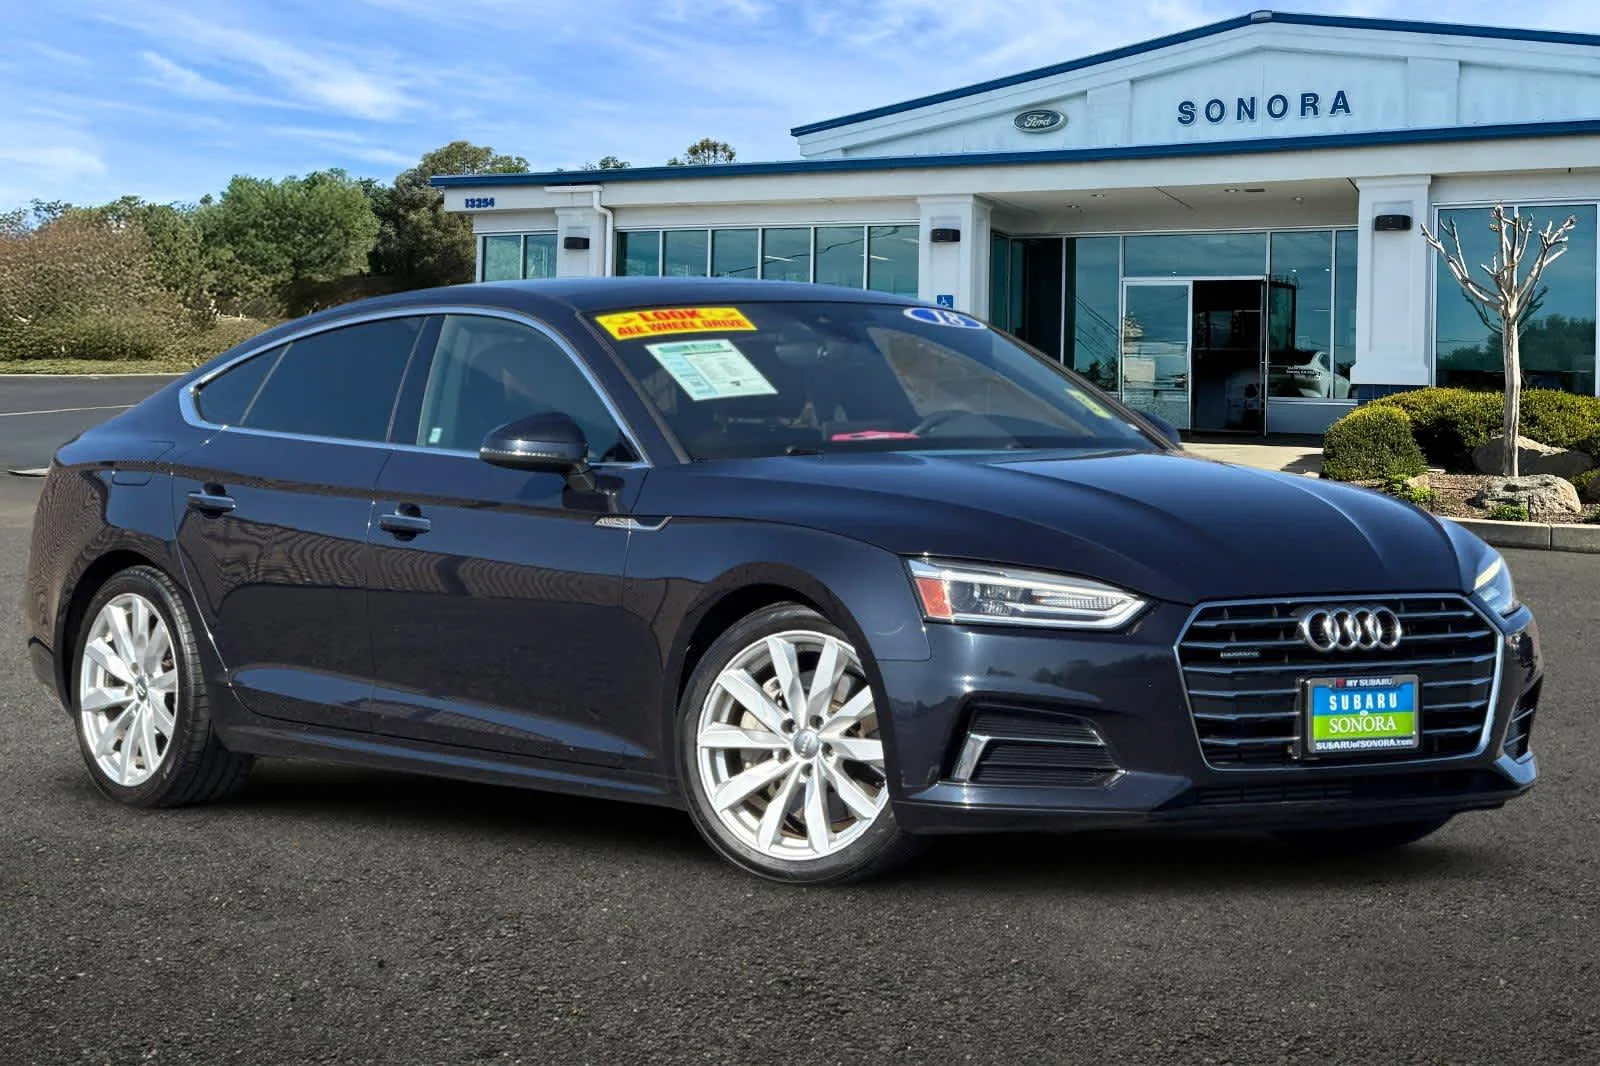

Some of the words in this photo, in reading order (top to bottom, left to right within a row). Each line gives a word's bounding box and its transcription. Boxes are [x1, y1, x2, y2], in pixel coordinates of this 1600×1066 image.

[1177, 90, 1352, 125] SONORA
[1024, 114, 1052, 128] Ford
[637, 309, 703, 322] LOOK
[617, 325, 646, 336] ALL
[648, 321, 698, 333] WHEEL
[701, 319, 746, 329] DRIVE
[1359, 678, 1393, 687] SUBARU
[1329, 692, 1398, 711] SUBARU
[1329, 716, 1397, 733] SONORA
